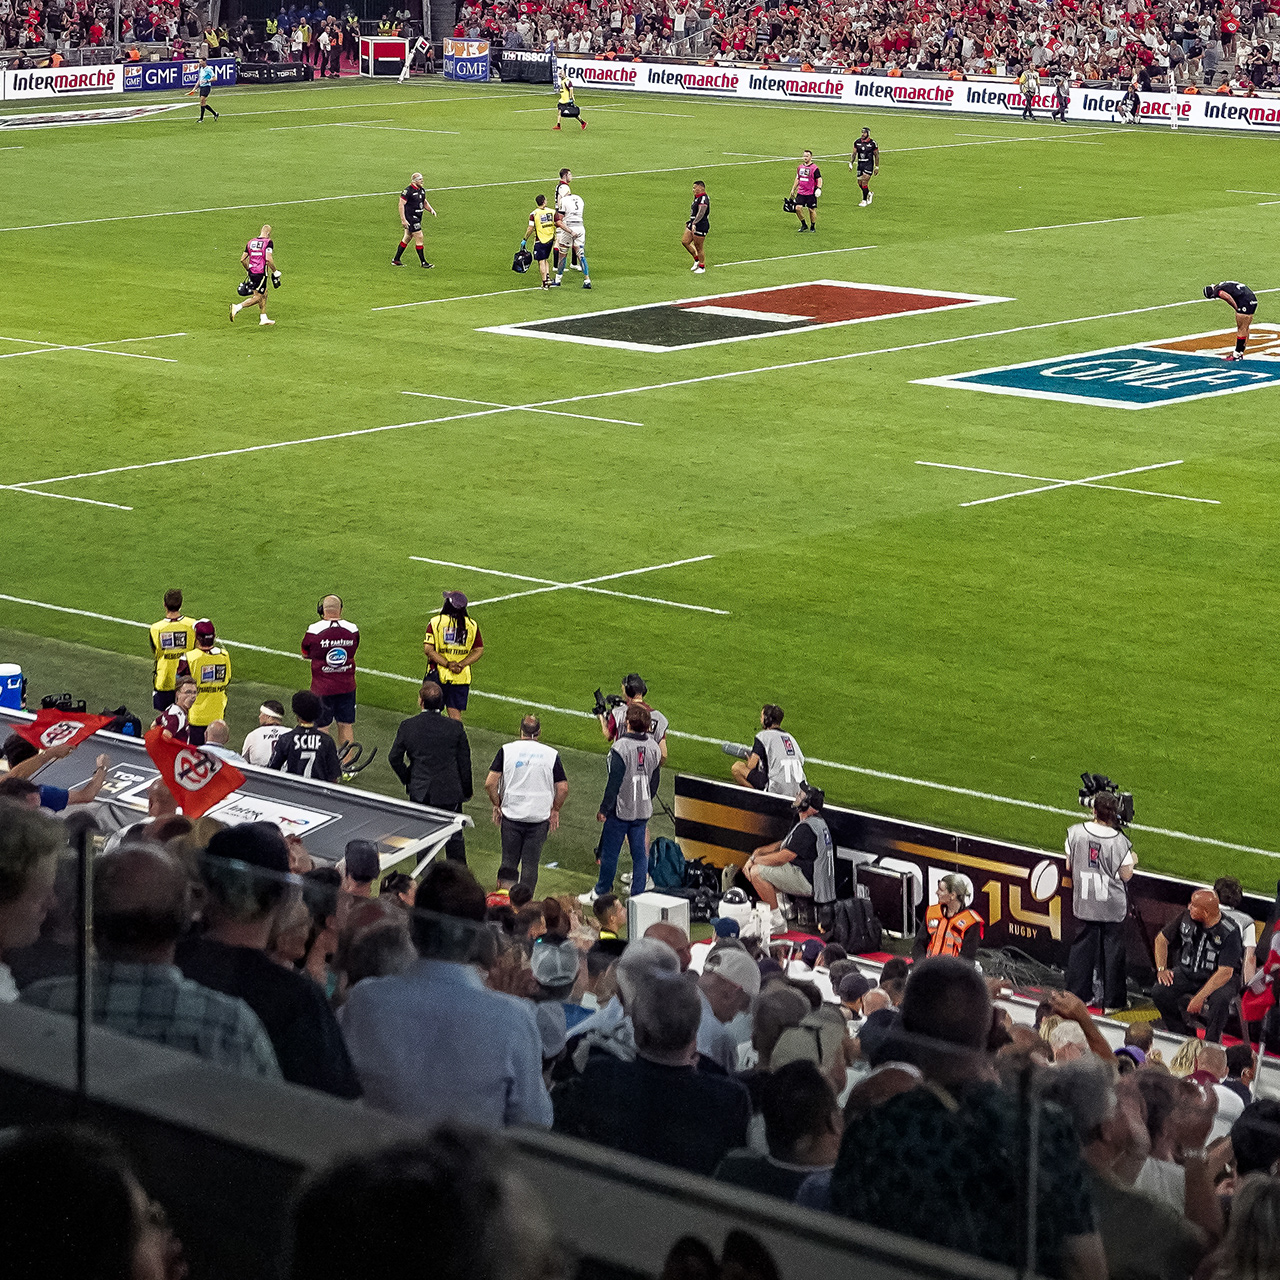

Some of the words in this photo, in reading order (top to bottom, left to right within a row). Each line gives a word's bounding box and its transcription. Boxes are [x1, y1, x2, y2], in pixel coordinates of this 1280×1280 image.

[516, 51, 551, 62] TISSOT
[146, 68, 178, 84] GMF
[457, 58, 486, 76] GMF
[126, 78, 141, 88] GMF
[184, 73, 198, 82] GMF
[1040, 358, 1273, 390] GMF
[300, 752, 316, 779] 7
[1080, 871, 1109, 902] TV
[1008, 922, 1038, 940] RUGBY
